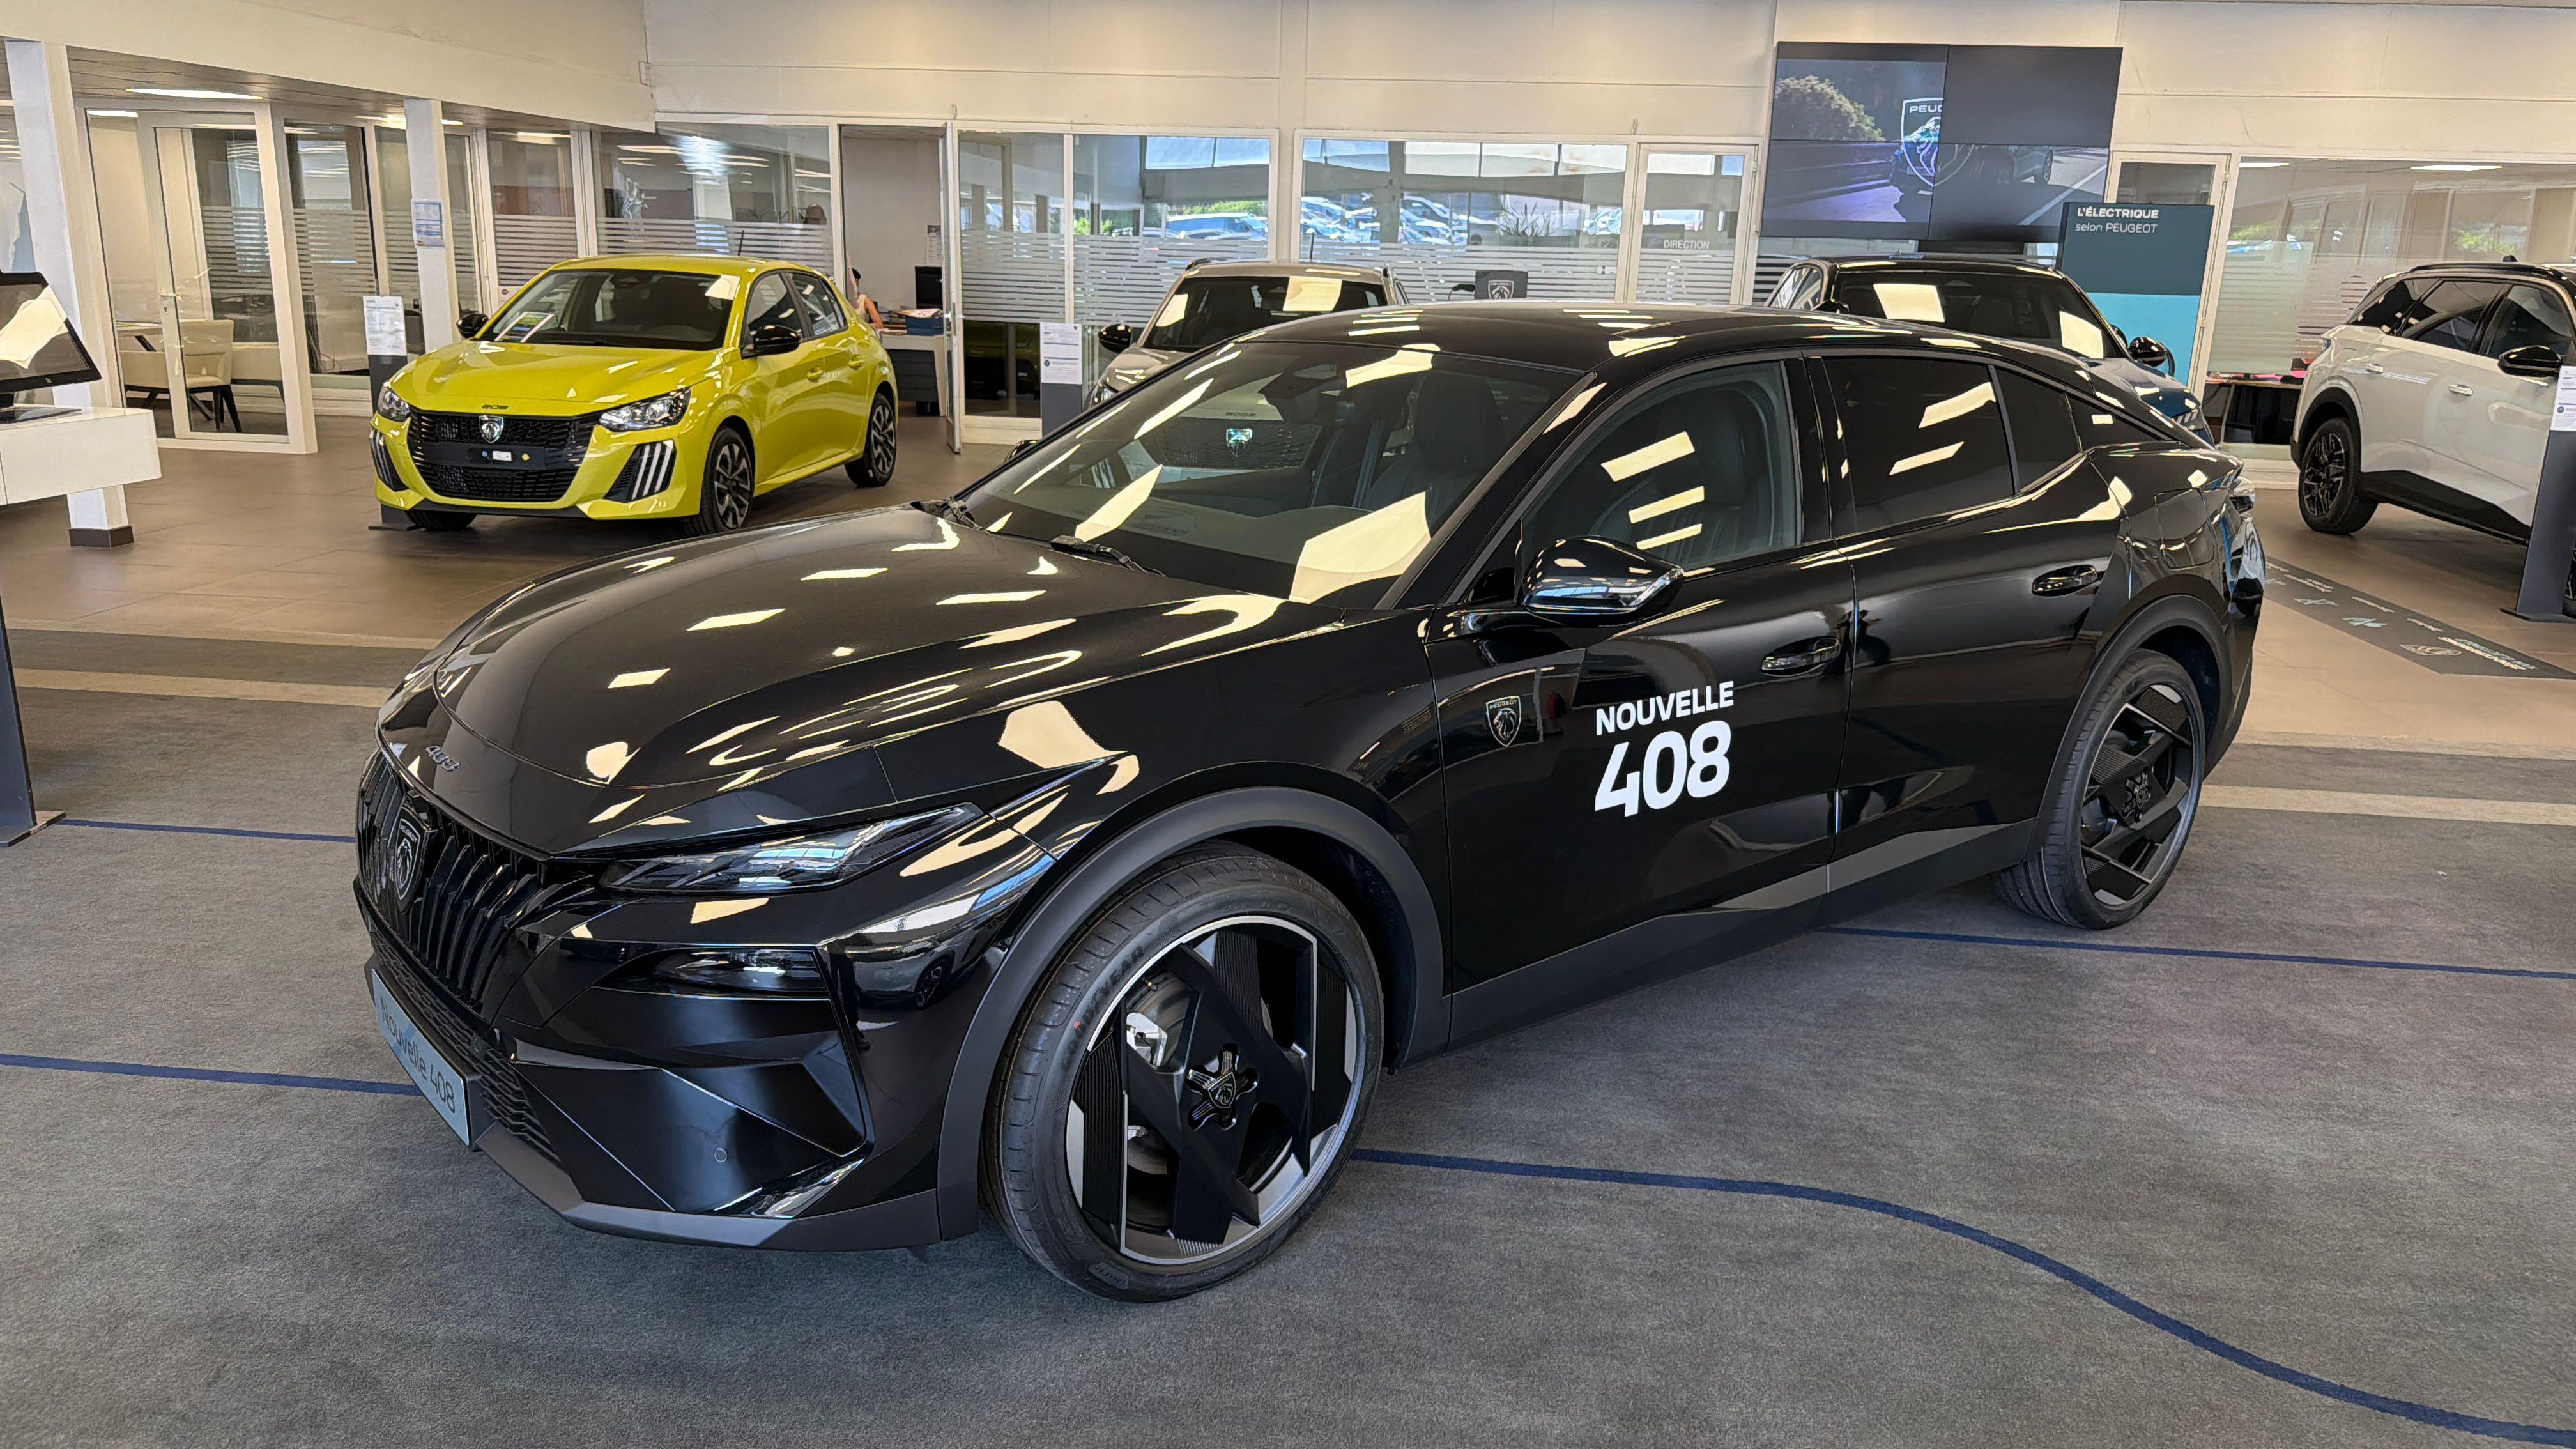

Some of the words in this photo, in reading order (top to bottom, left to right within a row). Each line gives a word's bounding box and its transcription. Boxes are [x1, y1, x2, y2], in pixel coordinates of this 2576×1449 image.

[2077, 206, 2159, 218] L'ÉLECTRIQUE
[2074, 222, 2103, 231] selon
[2105, 222, 2158, 233] PEUGEOT
[1663, 240, 1710, 250] DIRECTION
[1489, 700, 1517, 710] PEUGEOT
[1597, 680, 1734, 735] NOUVELLE
[425, 746, 460, 772] 408
[1595, 720, 1731, 817] 408
[380, 995, 427, 1081] Nouvelle
[430, 1064, 455, 1114] 408
